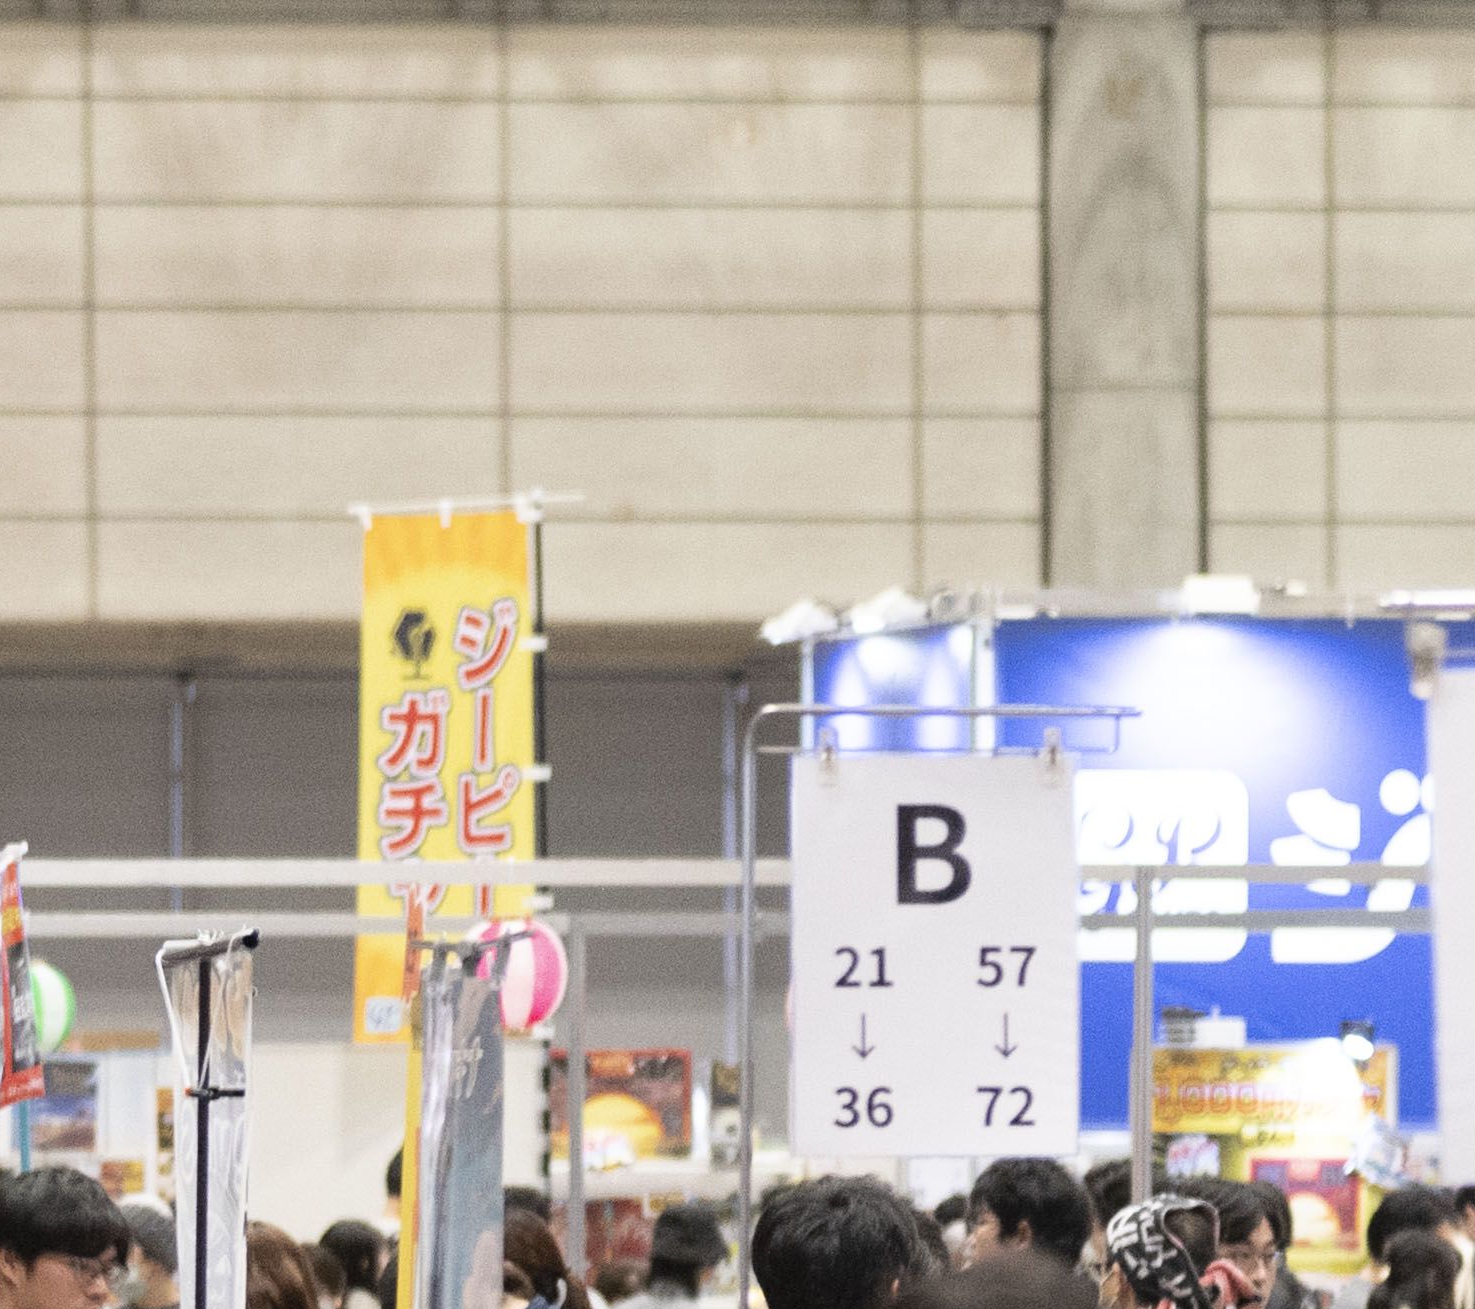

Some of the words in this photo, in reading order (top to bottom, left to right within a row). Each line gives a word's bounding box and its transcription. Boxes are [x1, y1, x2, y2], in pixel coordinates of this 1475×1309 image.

[897, 804, 972, 904] B
[835, 946, 893, 987] 21
[977, 946, 1037, 987] 57
[835, 1086, 894, 1128] 36
[976, 1086, 1036, 1127] 72
